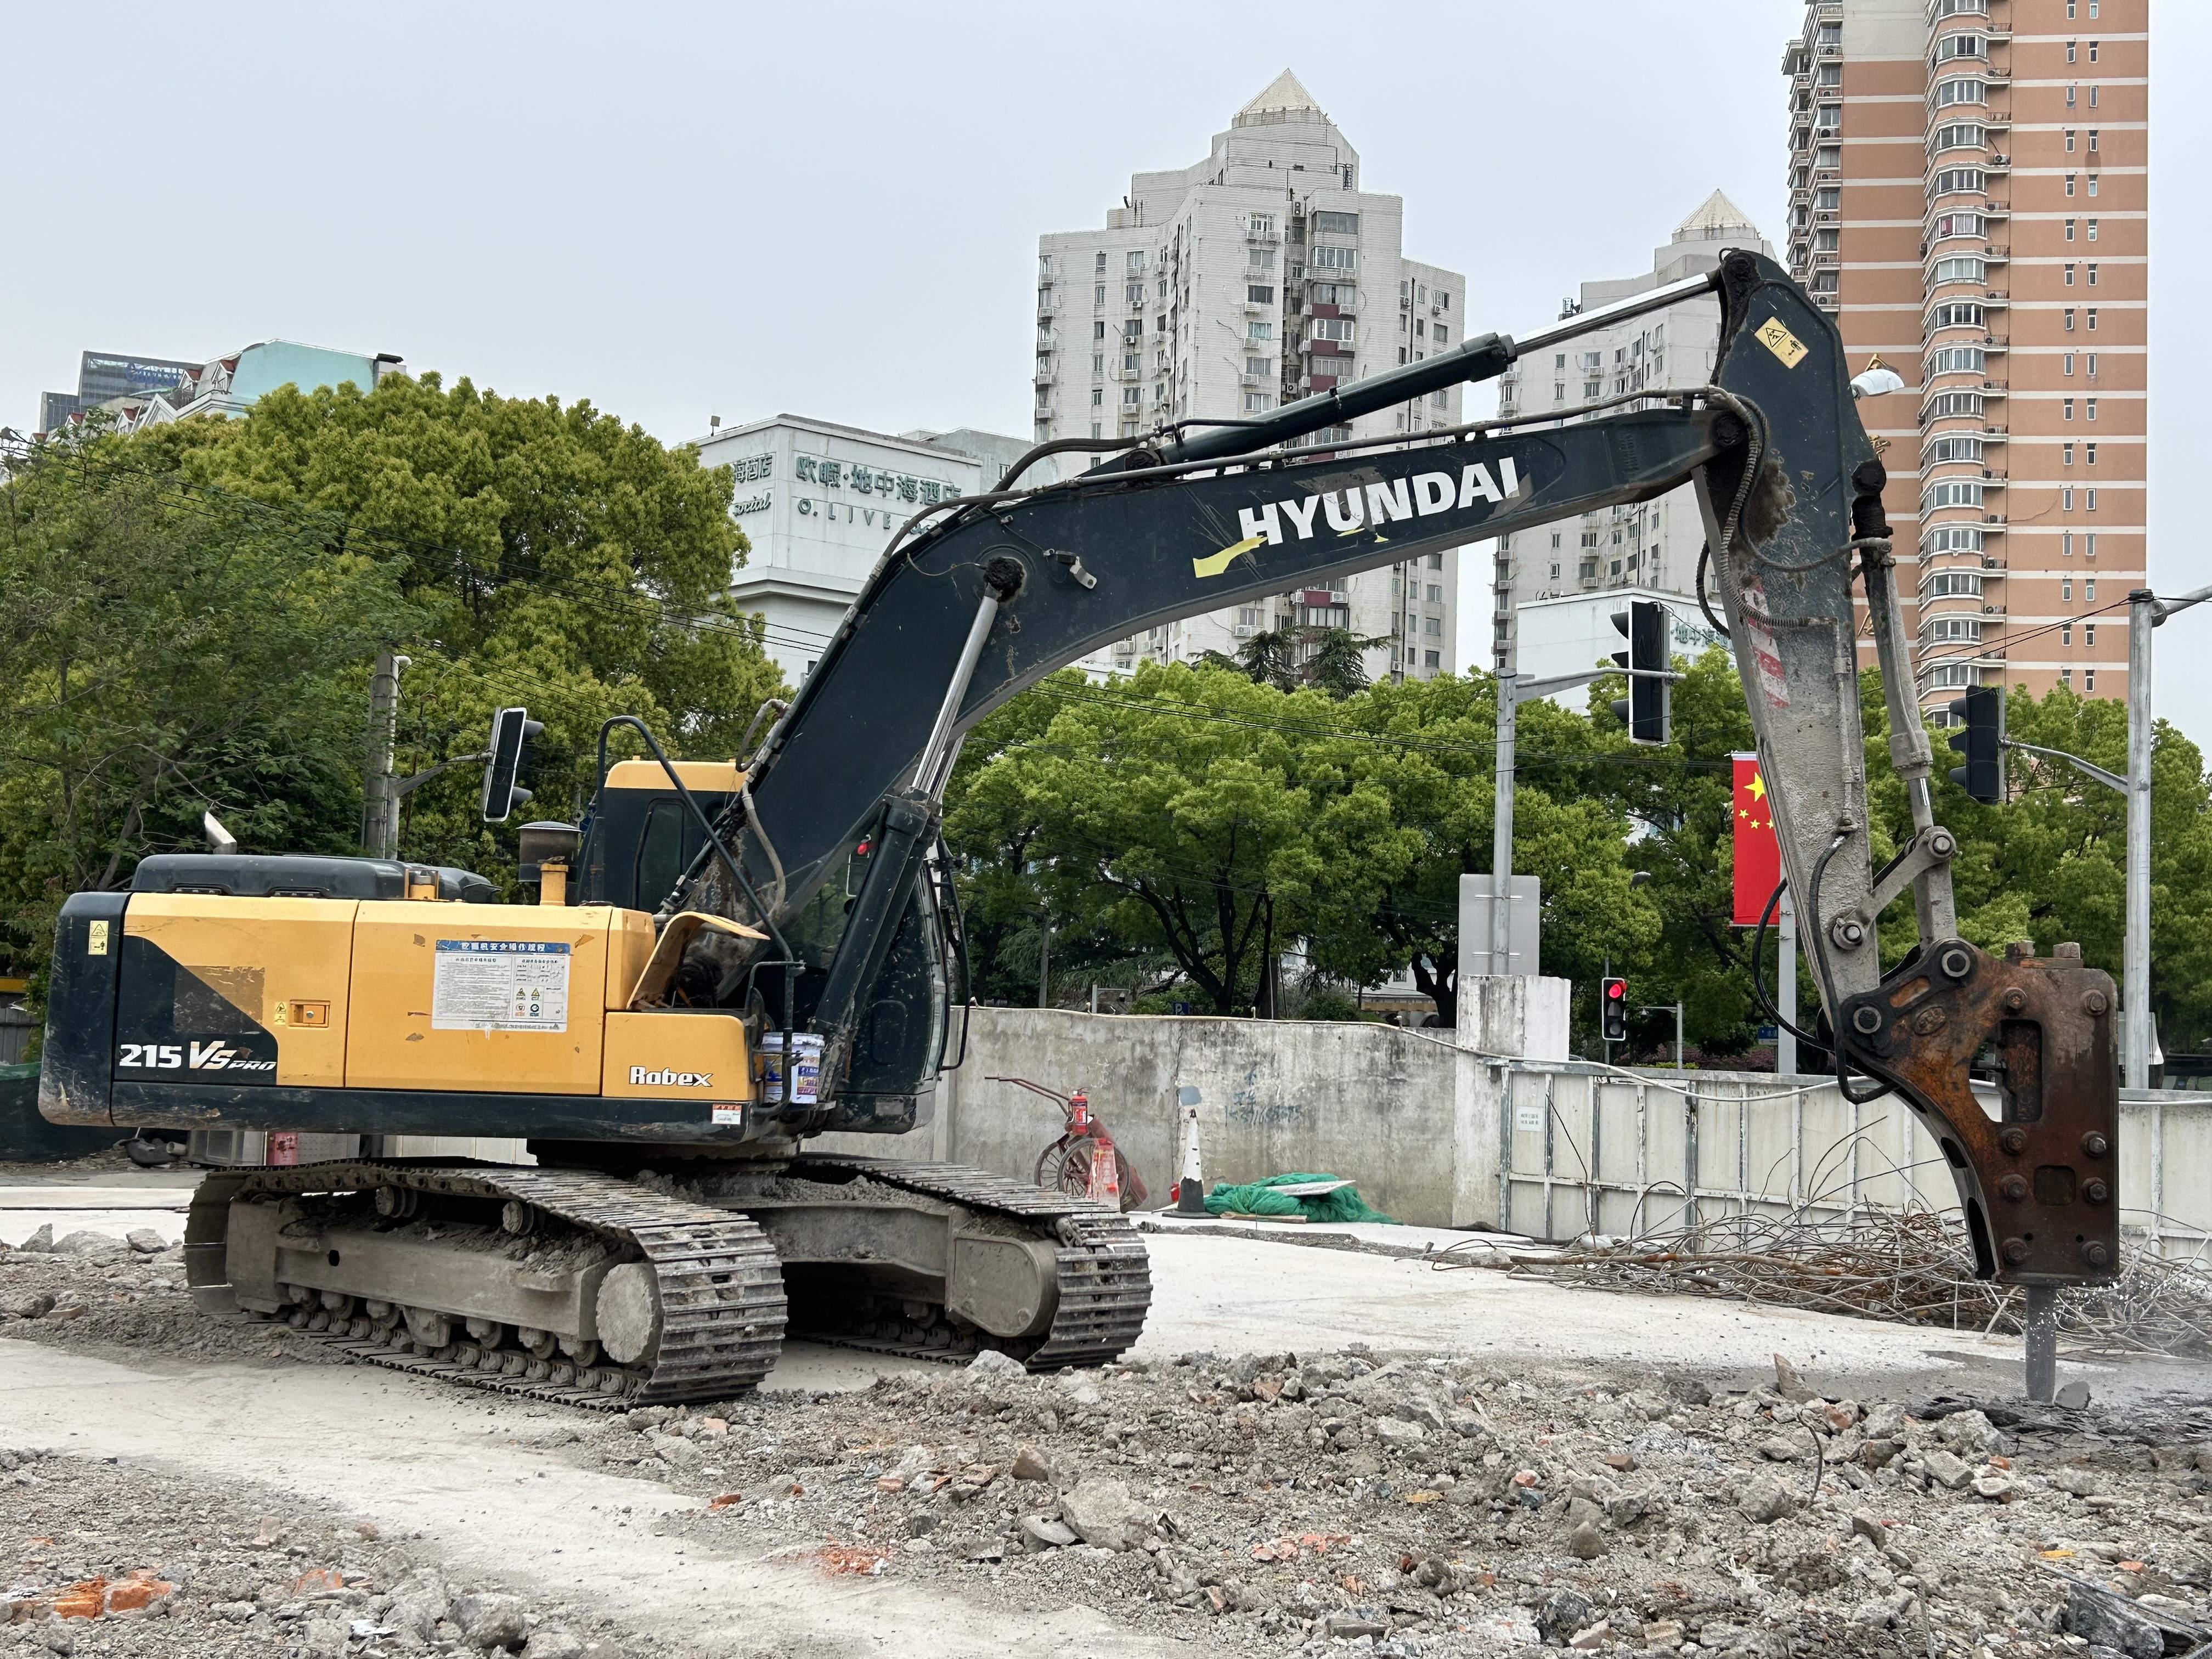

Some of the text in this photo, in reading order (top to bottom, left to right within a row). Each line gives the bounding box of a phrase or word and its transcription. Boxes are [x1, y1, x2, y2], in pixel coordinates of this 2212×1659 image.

[1238, 457, 1520, 545] HYUNDAI
[119, 1044, 182, 1068] 215
[228, 1060, 277, 1070] PRO
[629, 1066, 713, 1087] Robex
